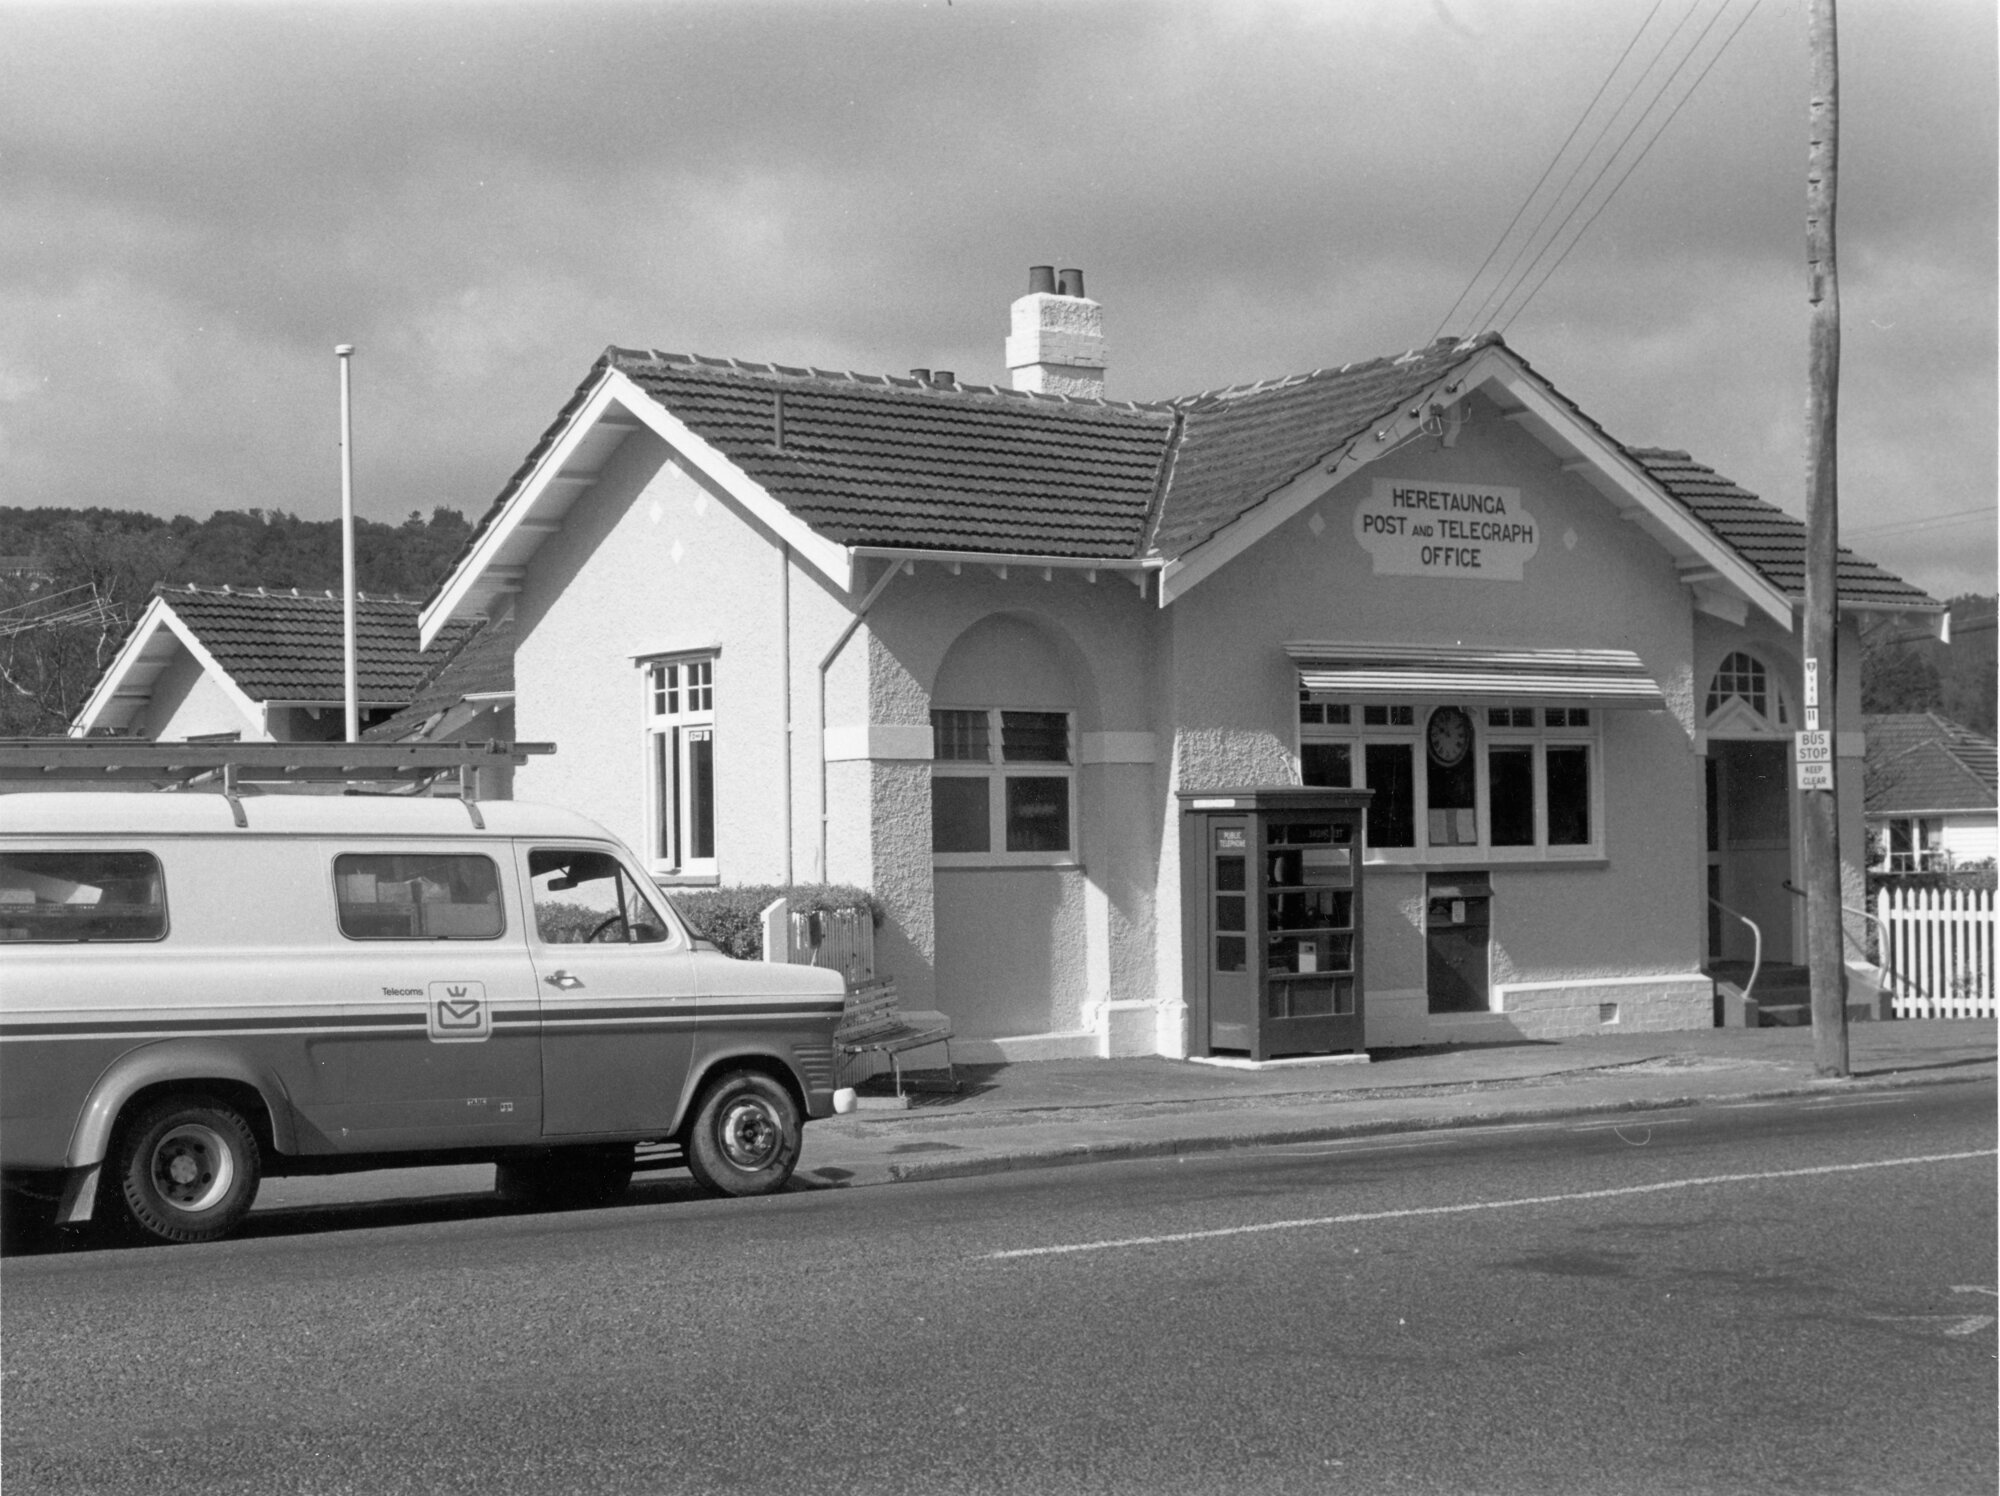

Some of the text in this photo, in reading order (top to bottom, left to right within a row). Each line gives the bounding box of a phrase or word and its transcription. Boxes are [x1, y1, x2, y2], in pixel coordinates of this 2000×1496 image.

[1393, 488, 1506, 515] HERETAUNGA
[1364, 514, 1533, 544] POST AND TELEGRAPH
[1421, 546, 1481, 568] OFFICE
[1802, 734, 1824, 745] BUS
[1800, 748, 1828, 759] STOP
[1805, 766, 1823, 774] KEEP
[1802, 777, 1827, 785] CLEAR
[382, 987, 424, 997] Telecoms
